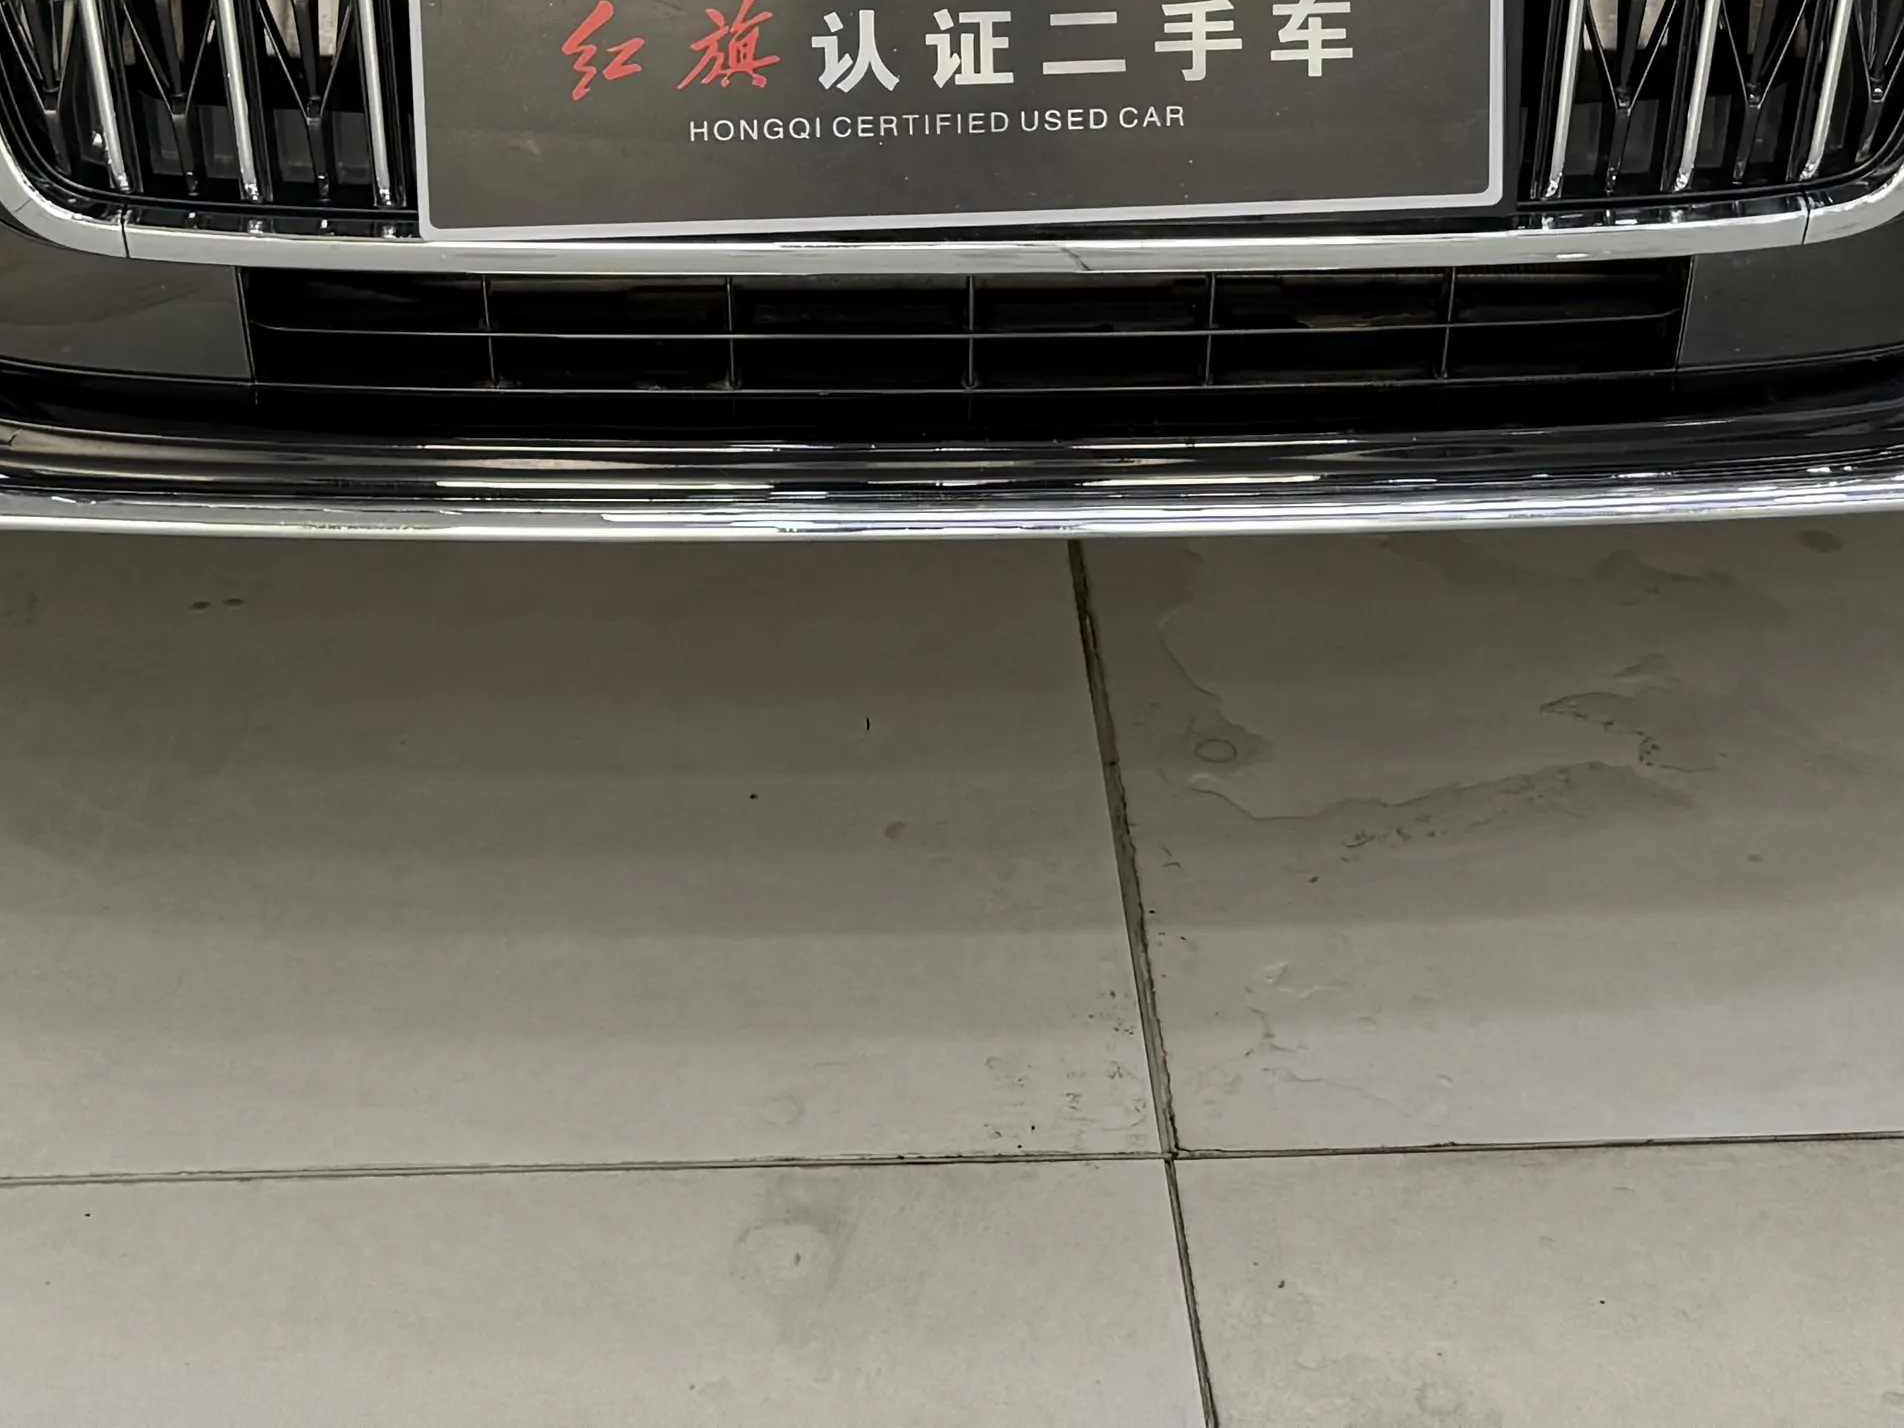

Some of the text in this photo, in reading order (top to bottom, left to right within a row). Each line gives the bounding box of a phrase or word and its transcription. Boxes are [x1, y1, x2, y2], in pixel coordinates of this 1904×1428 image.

[689, 105, 1186, 142] HONGQI CERTIFIED USED CAR
